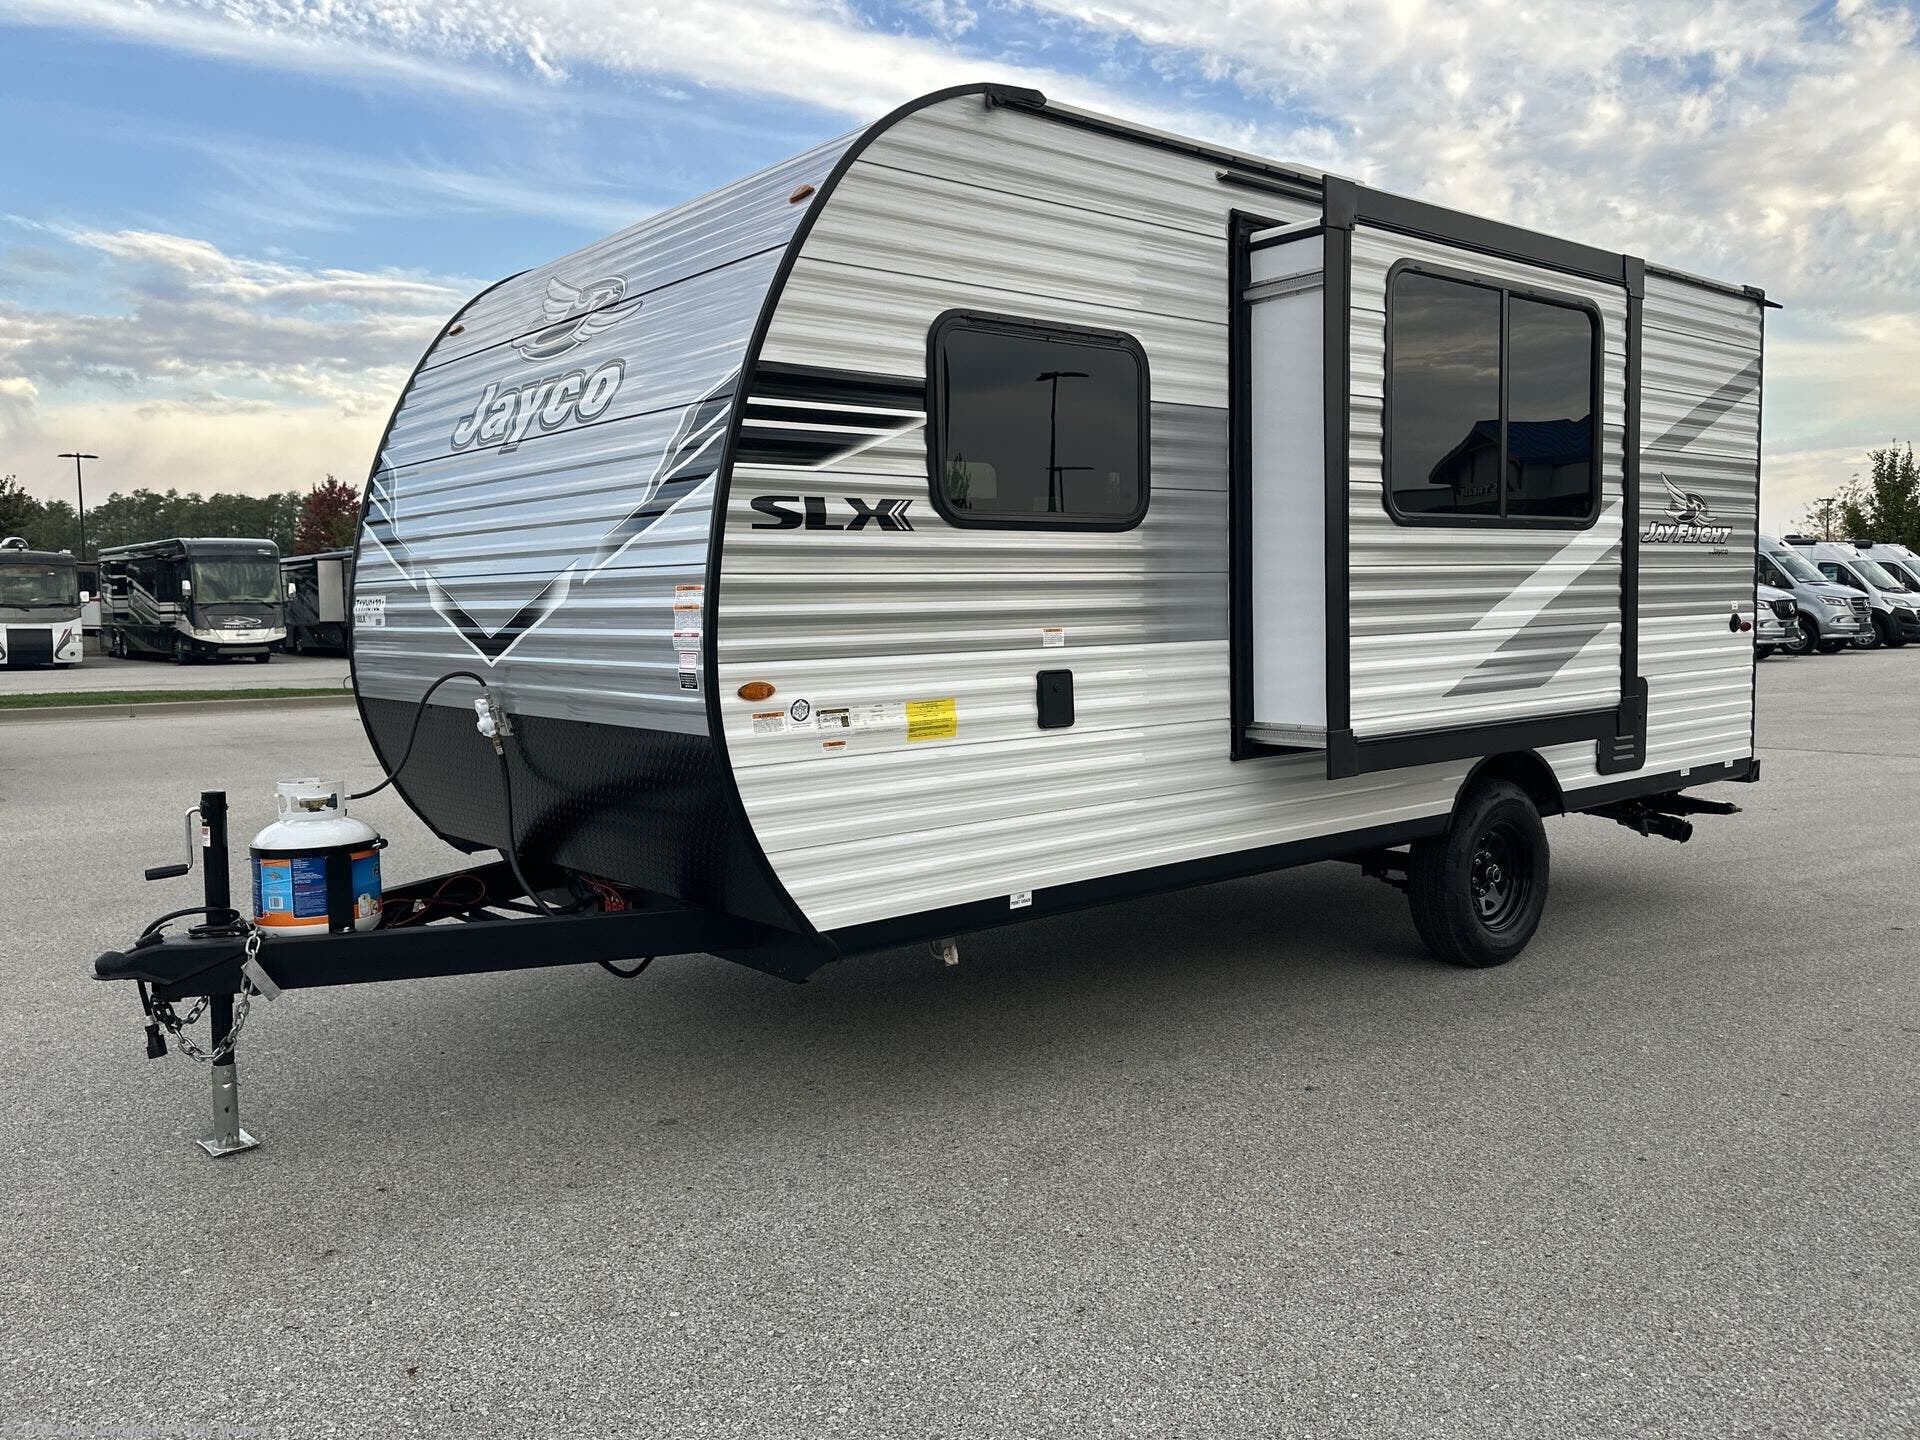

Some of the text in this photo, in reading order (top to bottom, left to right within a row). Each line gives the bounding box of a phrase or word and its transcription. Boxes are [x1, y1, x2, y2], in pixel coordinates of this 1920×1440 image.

[450, 357, 627, 455] Jayco
[750, 495, 914, 531] SLX
[1640, 521, 1732, 544] JAY FLIGHT
